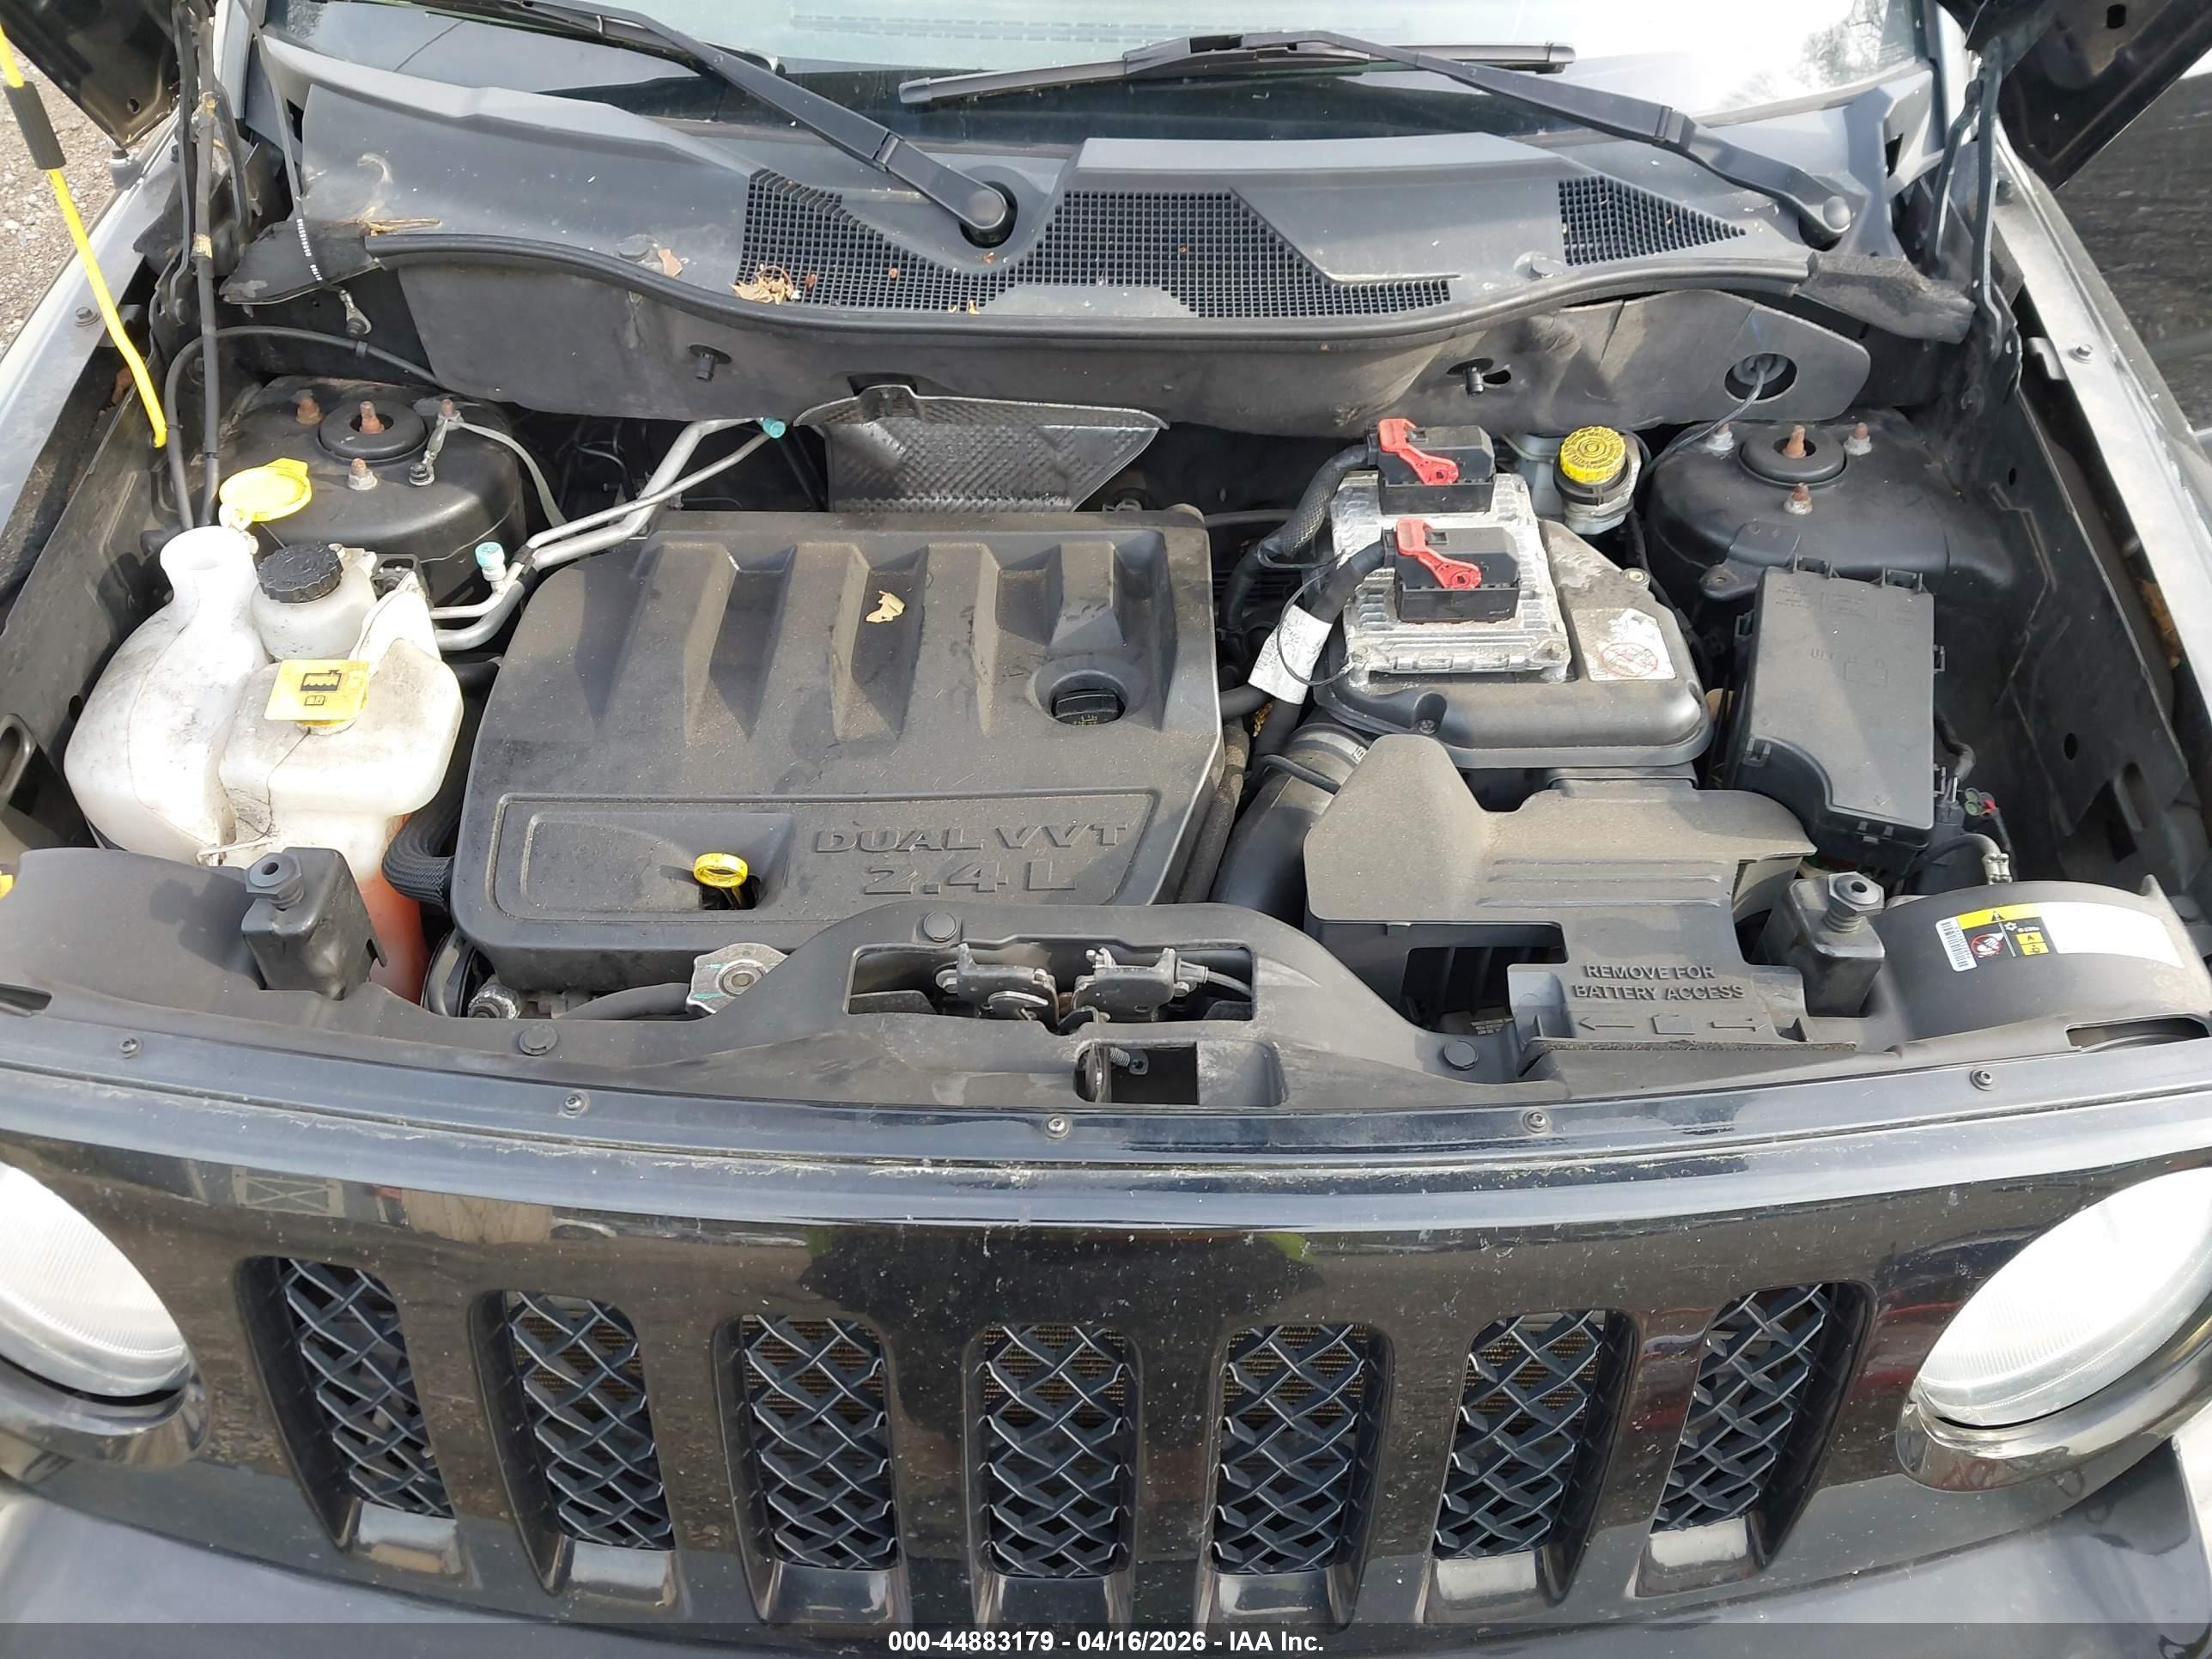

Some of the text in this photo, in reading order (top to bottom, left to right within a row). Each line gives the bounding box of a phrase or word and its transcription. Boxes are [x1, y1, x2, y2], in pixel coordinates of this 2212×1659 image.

[817, 823, 1128, 854] DUAL VVT
[1583, 964, 1717, 981] REMOVE FOR
[1572, 983, 1747, 1001] BATTERY ACCESS
